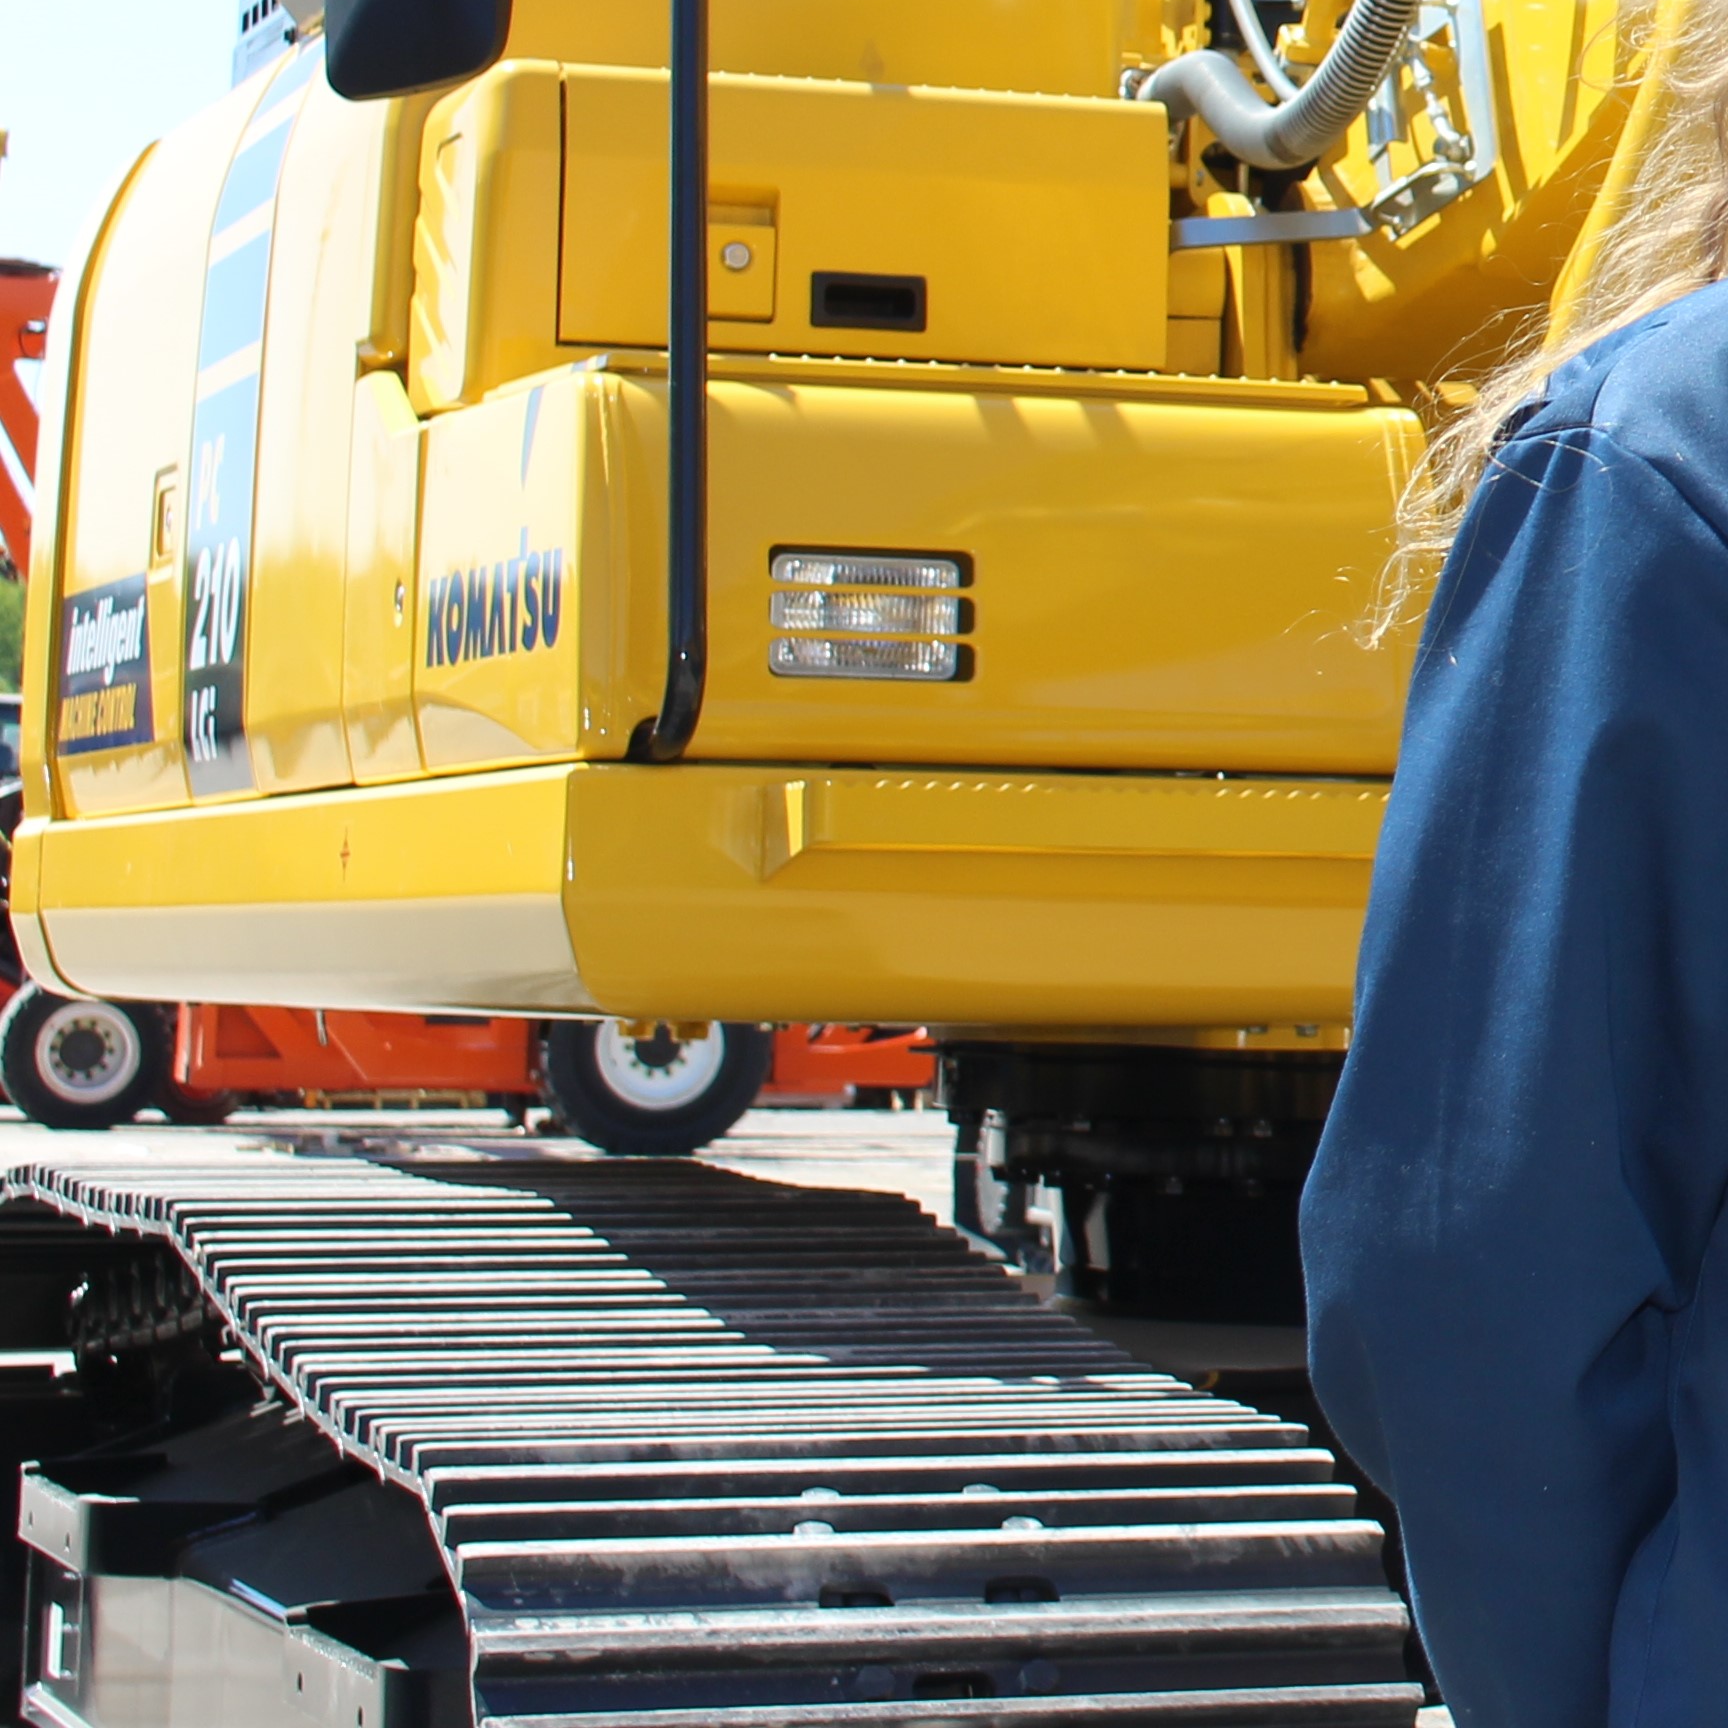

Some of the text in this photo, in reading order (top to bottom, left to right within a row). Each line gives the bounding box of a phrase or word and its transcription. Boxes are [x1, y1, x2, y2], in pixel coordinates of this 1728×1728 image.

[196, 432, 225, 530] PC
[67, 593, 145, 686] intelligent
[190, 536, 241, 670] 210
[426, 526, 562, 668] KOMATSU
